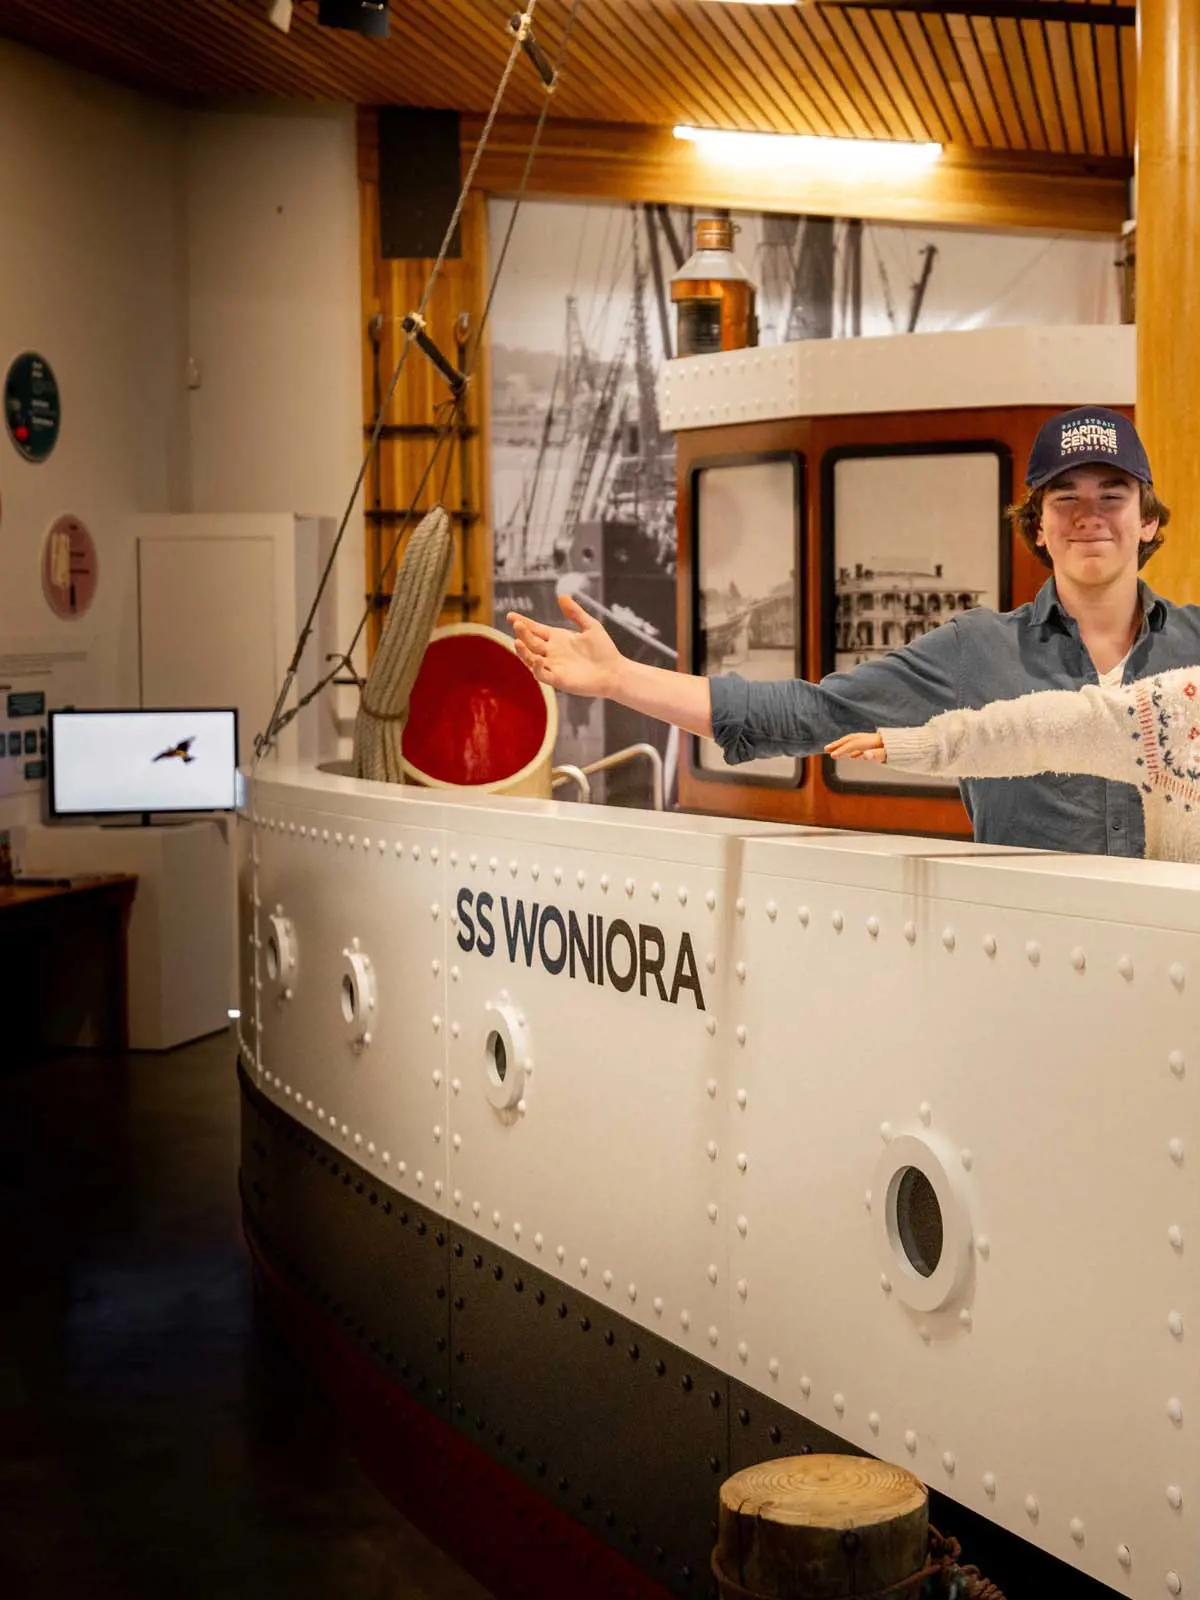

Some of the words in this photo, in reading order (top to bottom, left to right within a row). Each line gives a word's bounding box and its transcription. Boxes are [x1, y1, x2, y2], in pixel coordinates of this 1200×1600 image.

[1061, 420, 1081, 430] BASS
[1085, 418, 1116, 429] STRAIT
[1061, 424, 1117, 439] MARITIME
[1061, 434, 1118, 449] CENTRE
[1061, 445, 1118, 456] DEVONPORT
[457, 887, 495, 957] SS
[500, 896, 706, 1011] WONIORA
